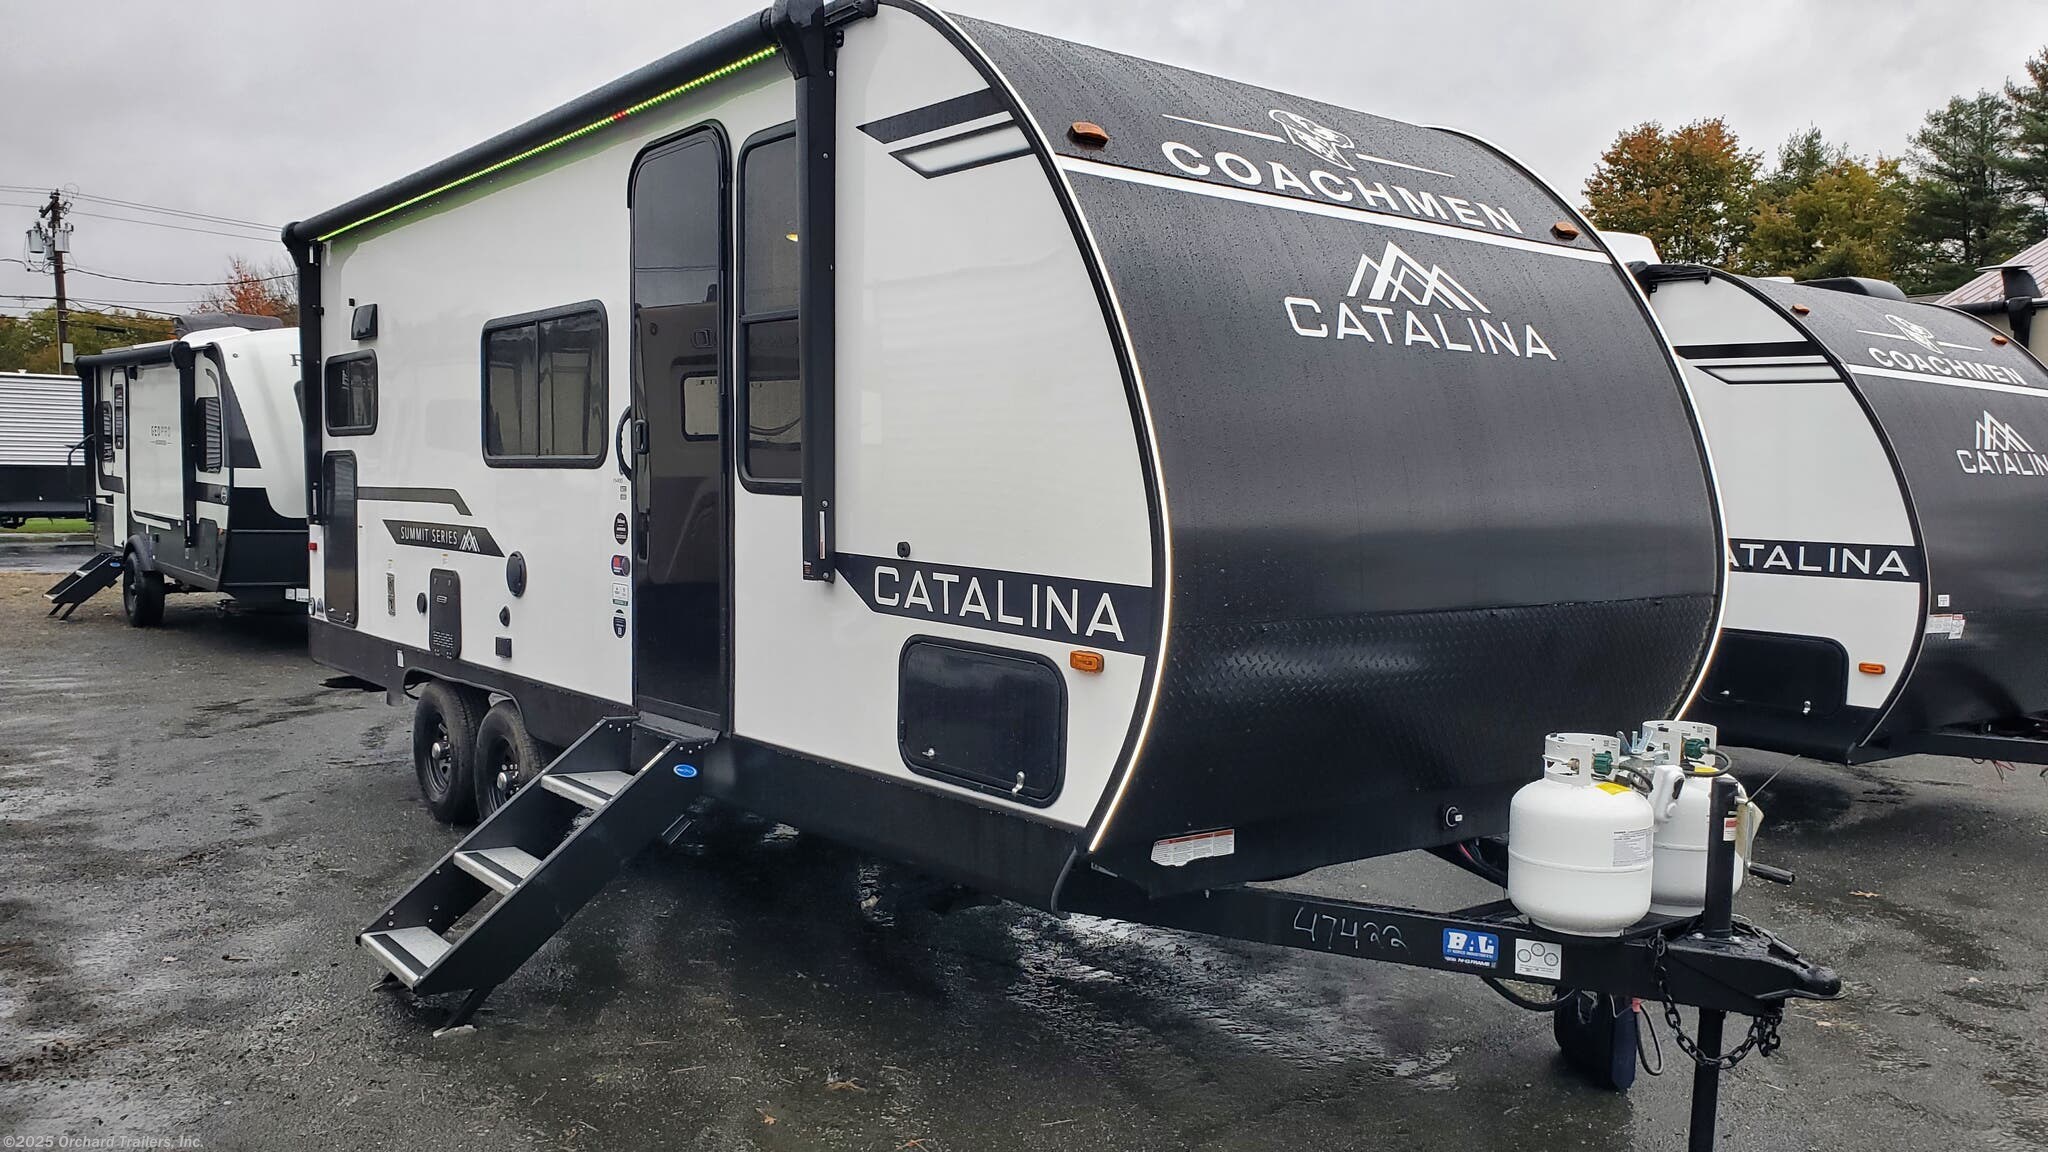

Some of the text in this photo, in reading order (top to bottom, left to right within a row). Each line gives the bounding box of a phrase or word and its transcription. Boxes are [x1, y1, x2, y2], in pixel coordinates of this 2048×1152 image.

[1161, 141, 1523, 234] COACHMEN
[1284, 296, 1557, 361] CATALINA
[1868, 347, 2028, 386] COACHMEN
[400, 526, 458, 545] SUMMIT SERIES
[874, 565, 1125, 642] CATALINA
[1293, 906, 1407, 949] 47422
[1447, 931, 1495, 955] BAL
